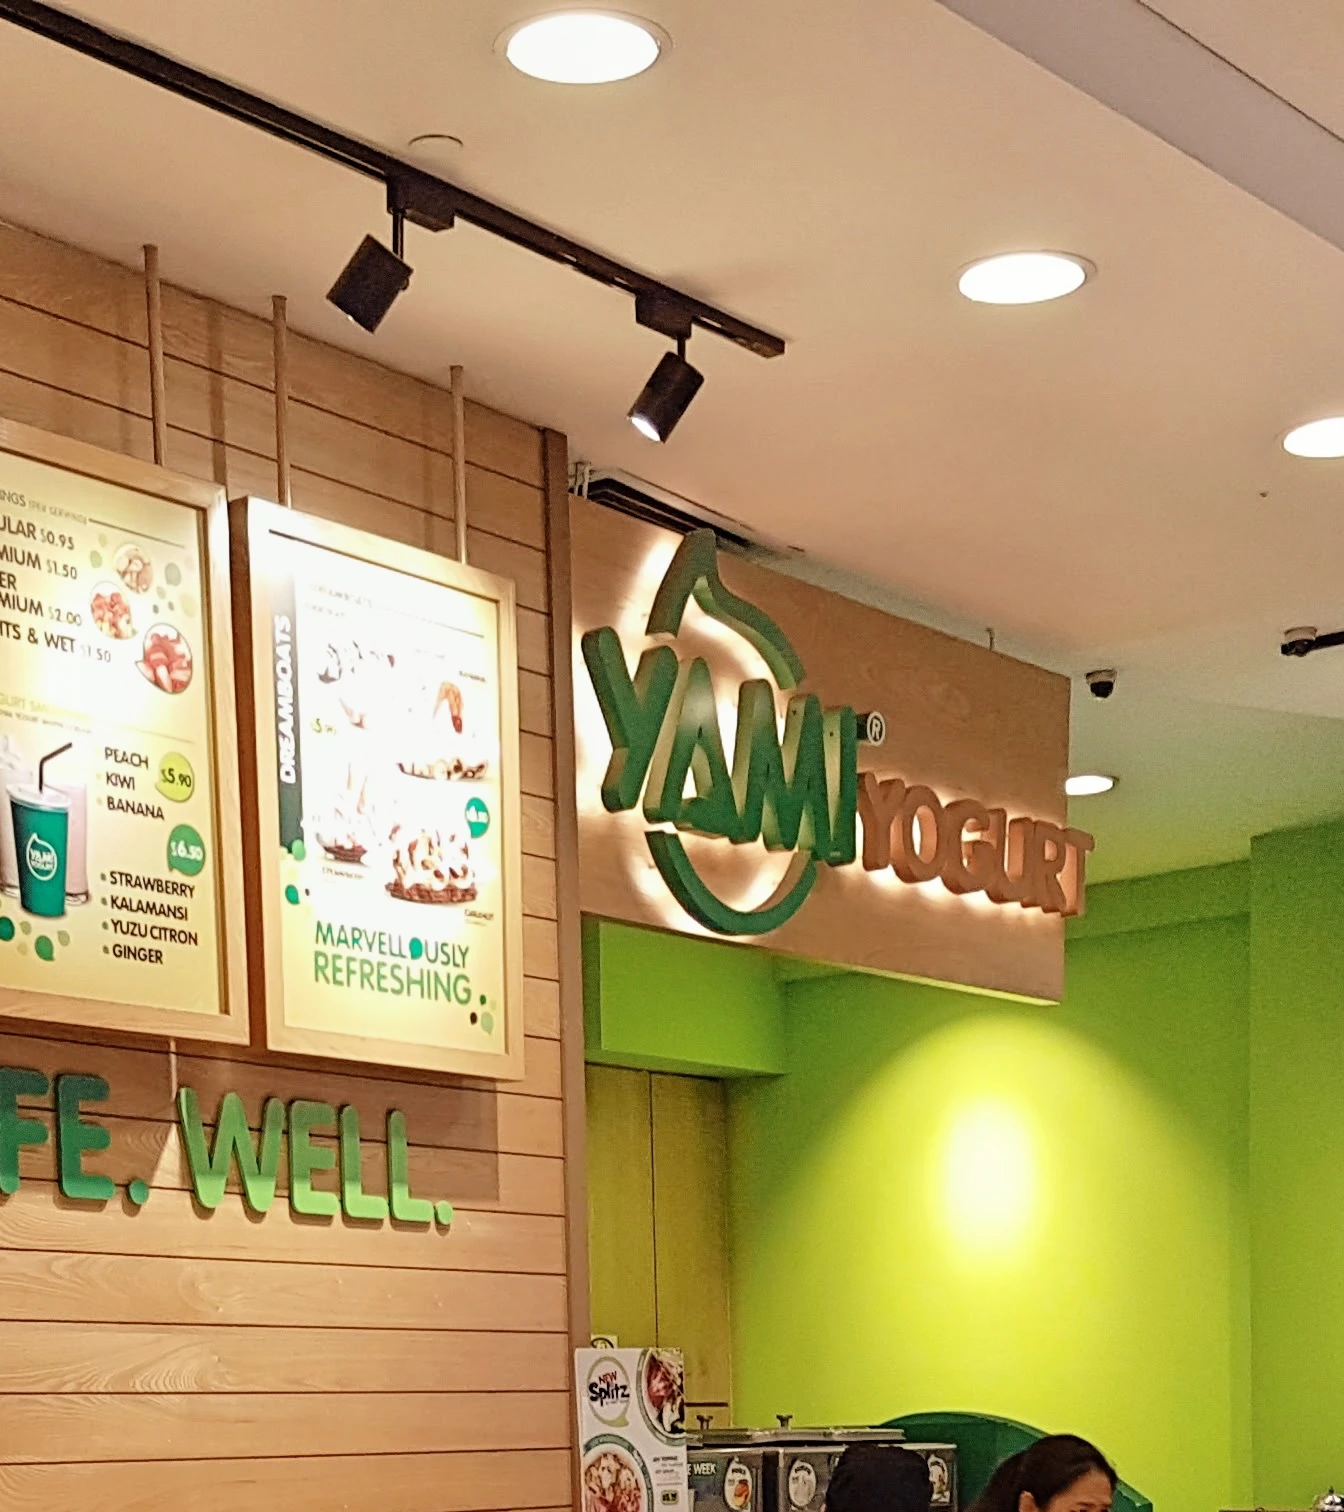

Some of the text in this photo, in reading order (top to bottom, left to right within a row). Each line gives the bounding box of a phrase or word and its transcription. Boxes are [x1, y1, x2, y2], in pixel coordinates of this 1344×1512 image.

[39, 528, 75, 551] $0.95
[27, 628, 39, 644] &
[44, 632, 76, 654] WET
[80, 642, 112, 663] $150
[274, 615, 296, 784] DREAMBOATS
[104, 746, 149, 771] PEACH
[581, 625, 858, 866] YAMI
[857, 770, 1095, 917] YOGURT
[105, 771, 136, 791] KIWI
[106, 795, 166, 821] BANANA
[109, 870, 196, 900] STRAWBERRY
[110, 895, 189, 921] KALAMANSI
[111, 919, 198, 947] YUZU CITRON
[112, 944, 164, 965] GINGER
[313, 950, 472, 1005] REFRESHING
[176, 1086, 454, 1226] WELL.
[598, 1370, 618, 1385] NEW
[588, 1382, 631, 1407] Splitz
[693, 1462, 717, 1476] WEEK
